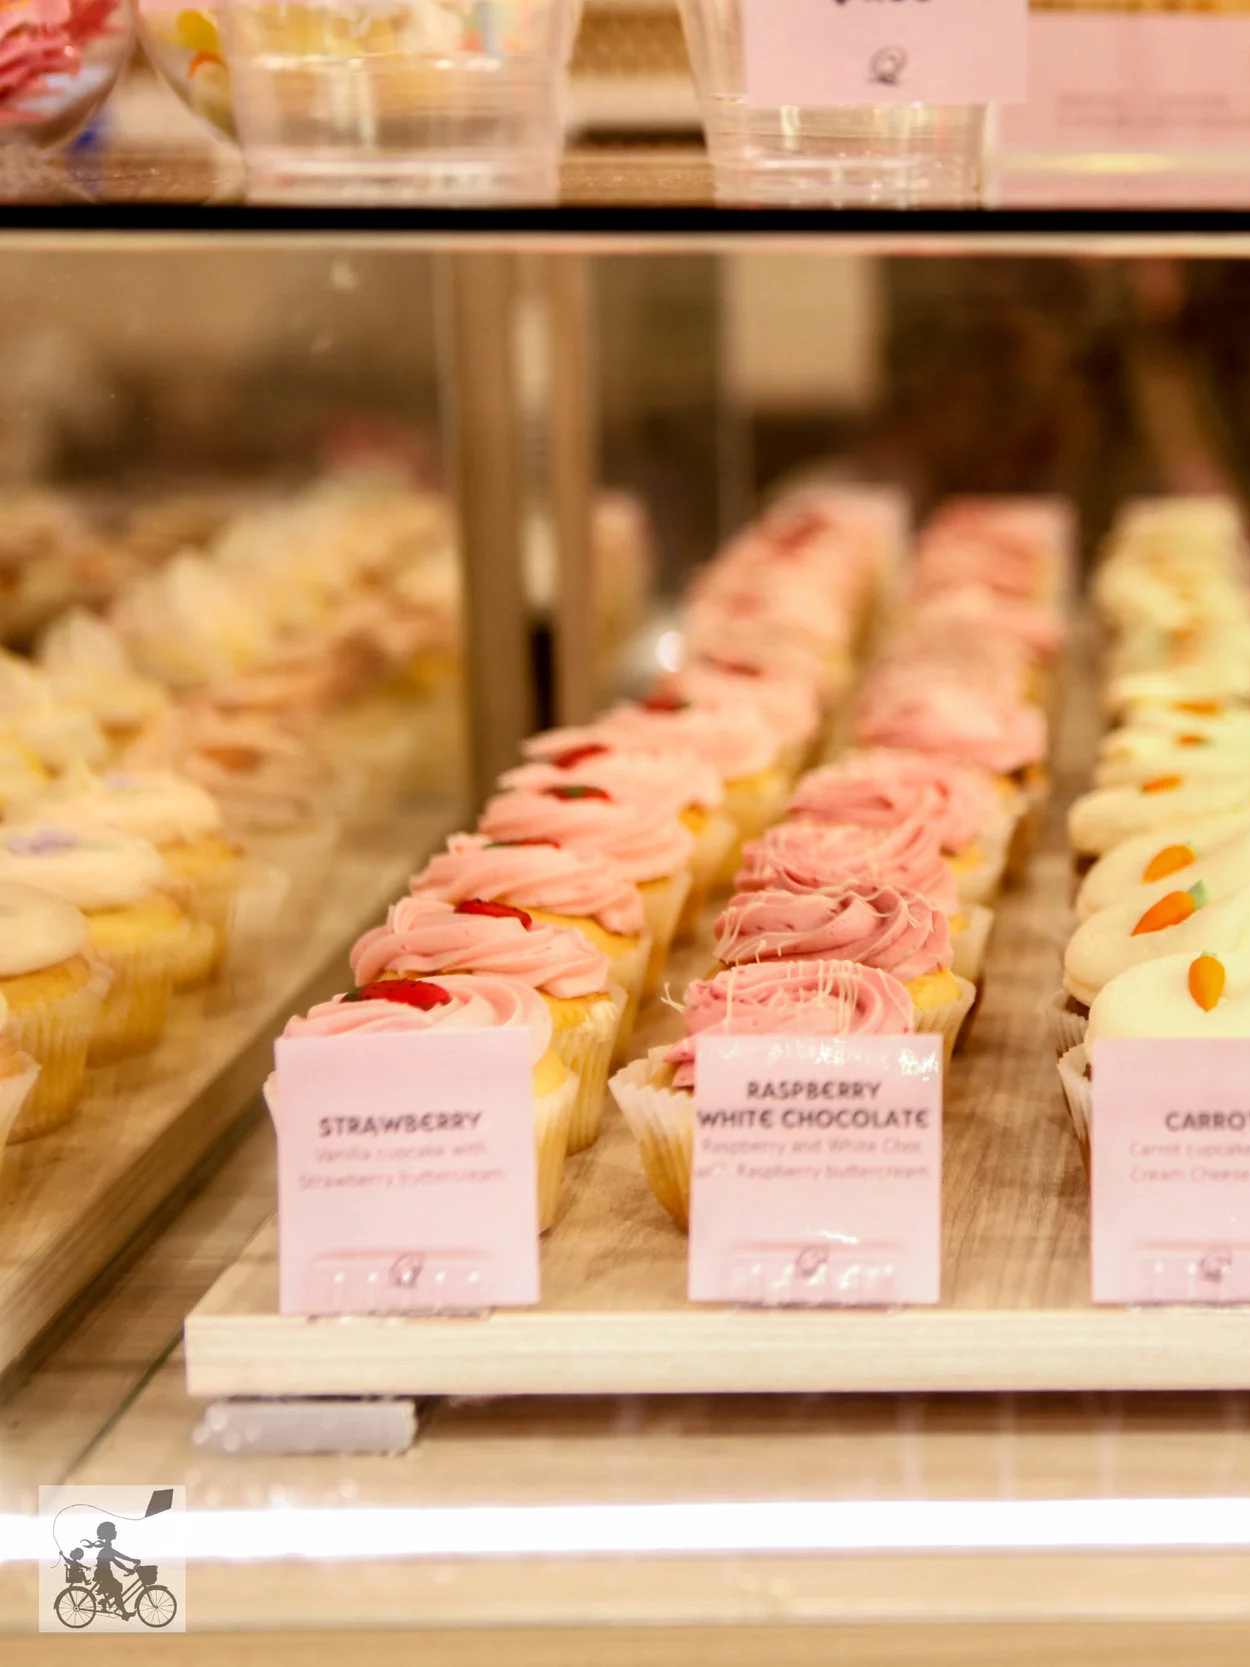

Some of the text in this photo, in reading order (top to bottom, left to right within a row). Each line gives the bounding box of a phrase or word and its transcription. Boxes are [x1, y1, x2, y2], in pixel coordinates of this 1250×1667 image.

[747, 1081, 882, 1100] RASPBERRY
[318, 1110, 483, 1138] STRAWBERRY
[697, 1109, 931, 1130] WHITE CHOCOLATE
